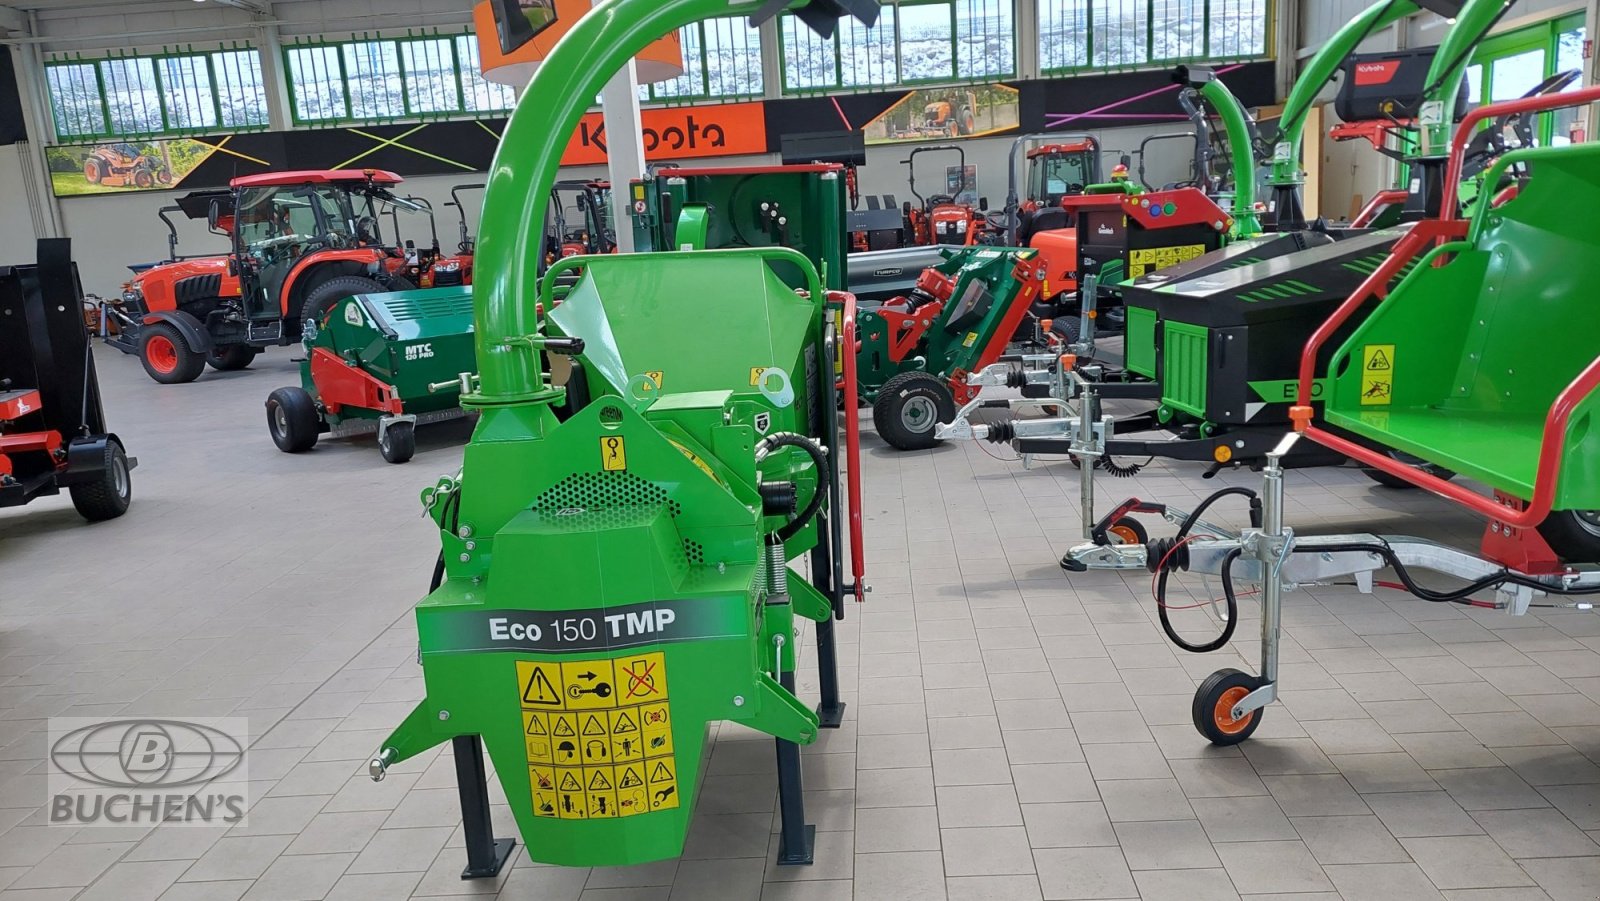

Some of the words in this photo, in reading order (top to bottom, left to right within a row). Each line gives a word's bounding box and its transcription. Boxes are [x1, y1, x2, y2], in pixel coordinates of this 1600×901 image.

[580, 115, 725, 154] Kota
[405, 343, 432, 355] MTC
[418, 351, 434, 359] PRO
[1283, 382, 1324, 398] EO
[489, 617, 542, 642] Eco
[550, 617, 597, 642] 150
[604, 608, 676, 638] TMP
